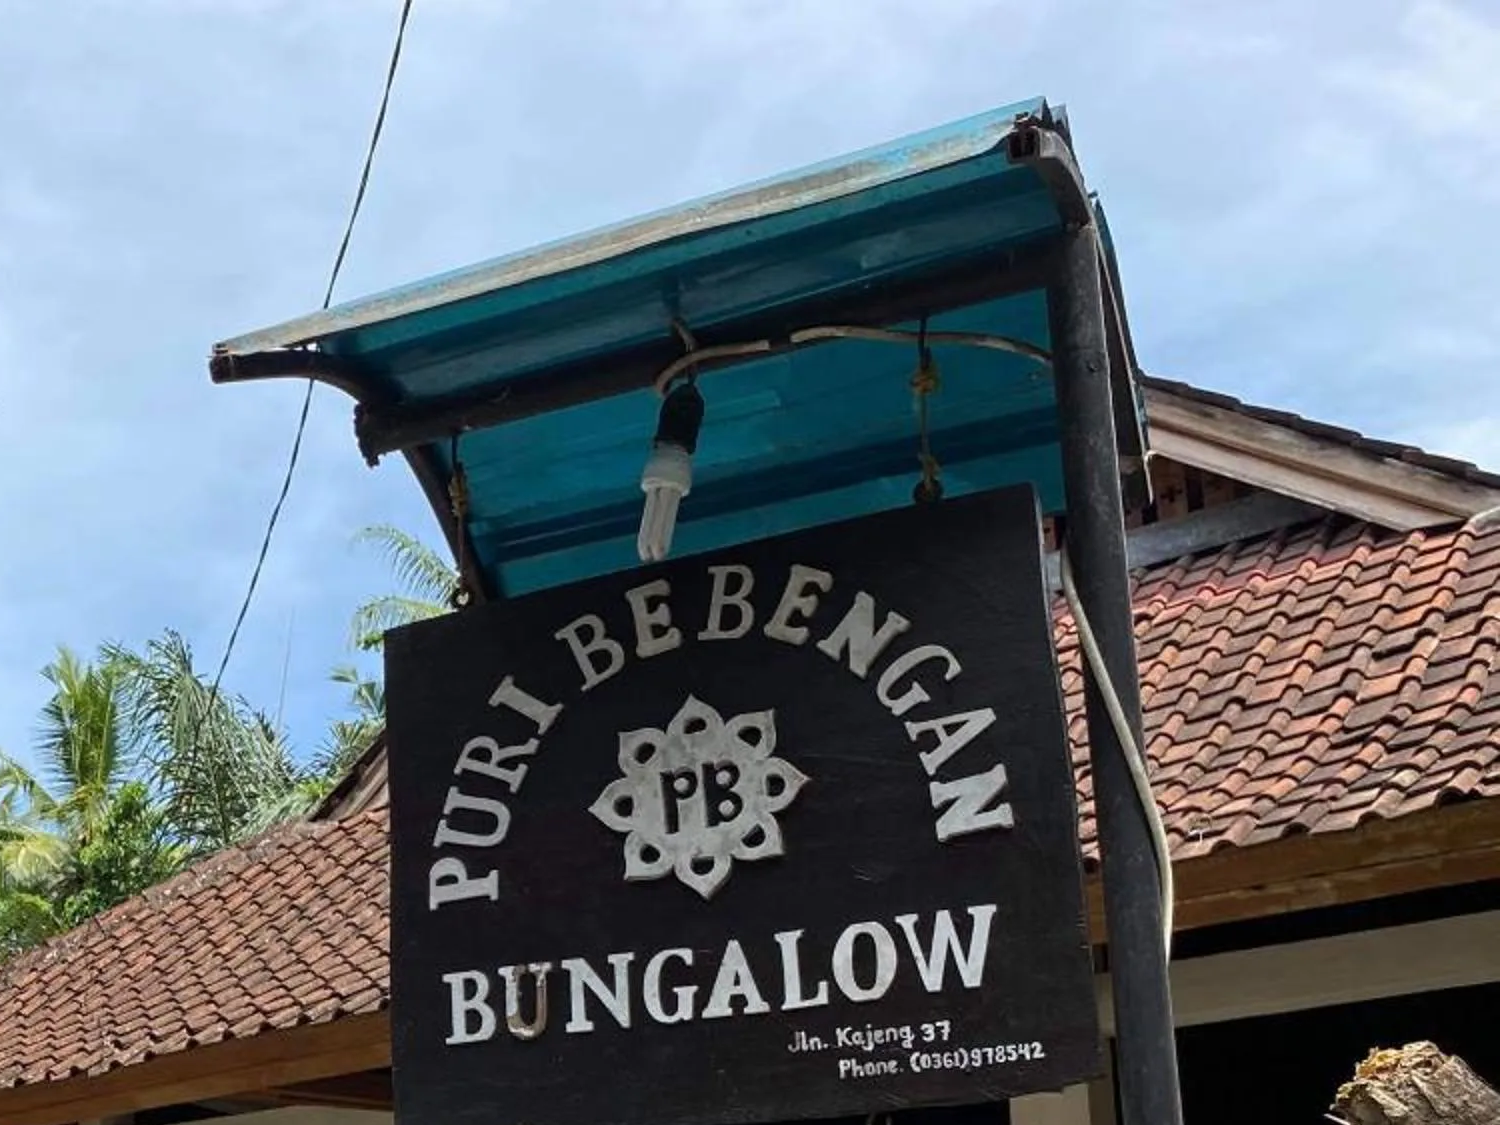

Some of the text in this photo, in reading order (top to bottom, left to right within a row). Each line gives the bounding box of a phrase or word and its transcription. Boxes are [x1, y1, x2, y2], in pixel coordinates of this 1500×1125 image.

[429, 676, 563, 910] PURI
[443, 905, 998, 1045] BUNGALOW
[788, 1020, 952, 1053] Jln. Kajeng 37
